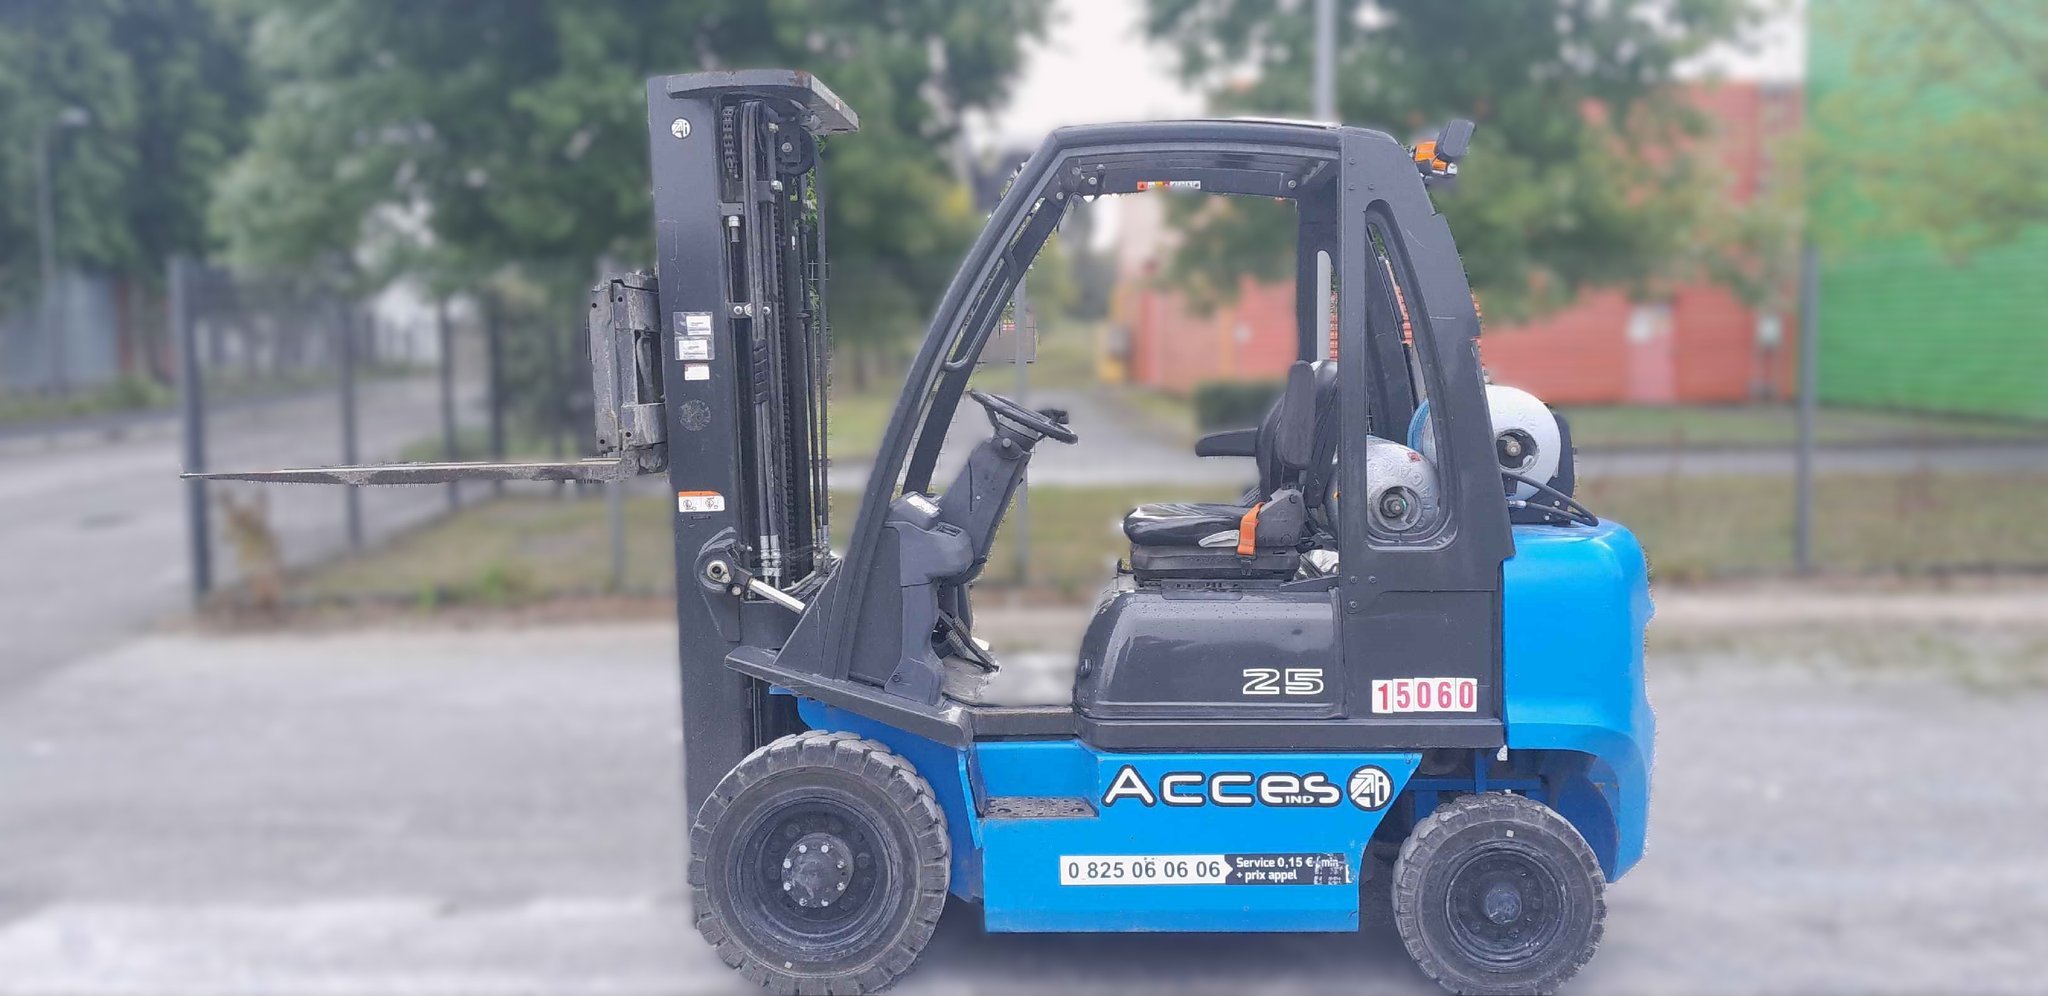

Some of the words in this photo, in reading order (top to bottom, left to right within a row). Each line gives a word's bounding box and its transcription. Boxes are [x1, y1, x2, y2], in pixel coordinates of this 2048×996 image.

[1242, 668, 1324, 695] 25
[1377, 681, 1474, 710] 15060
[1103, 766, 1341, 806] Acces
[1285, 795, 1314, 804] IND
[1068, 861, 1080, 879] 0
[1087, 861, 1125, 878] 825
[1132, 861, 1157, 878] 06
[1163, 861, 1189, 878] 06
[1196, 861, 1221, 878] 06
[1236, 857, 1276, 868] Service
[1277, 857, 1303, 869] 0,15
[1245, 868, 1266, 884] prix
[1268, 868, 1298, 884] appel
